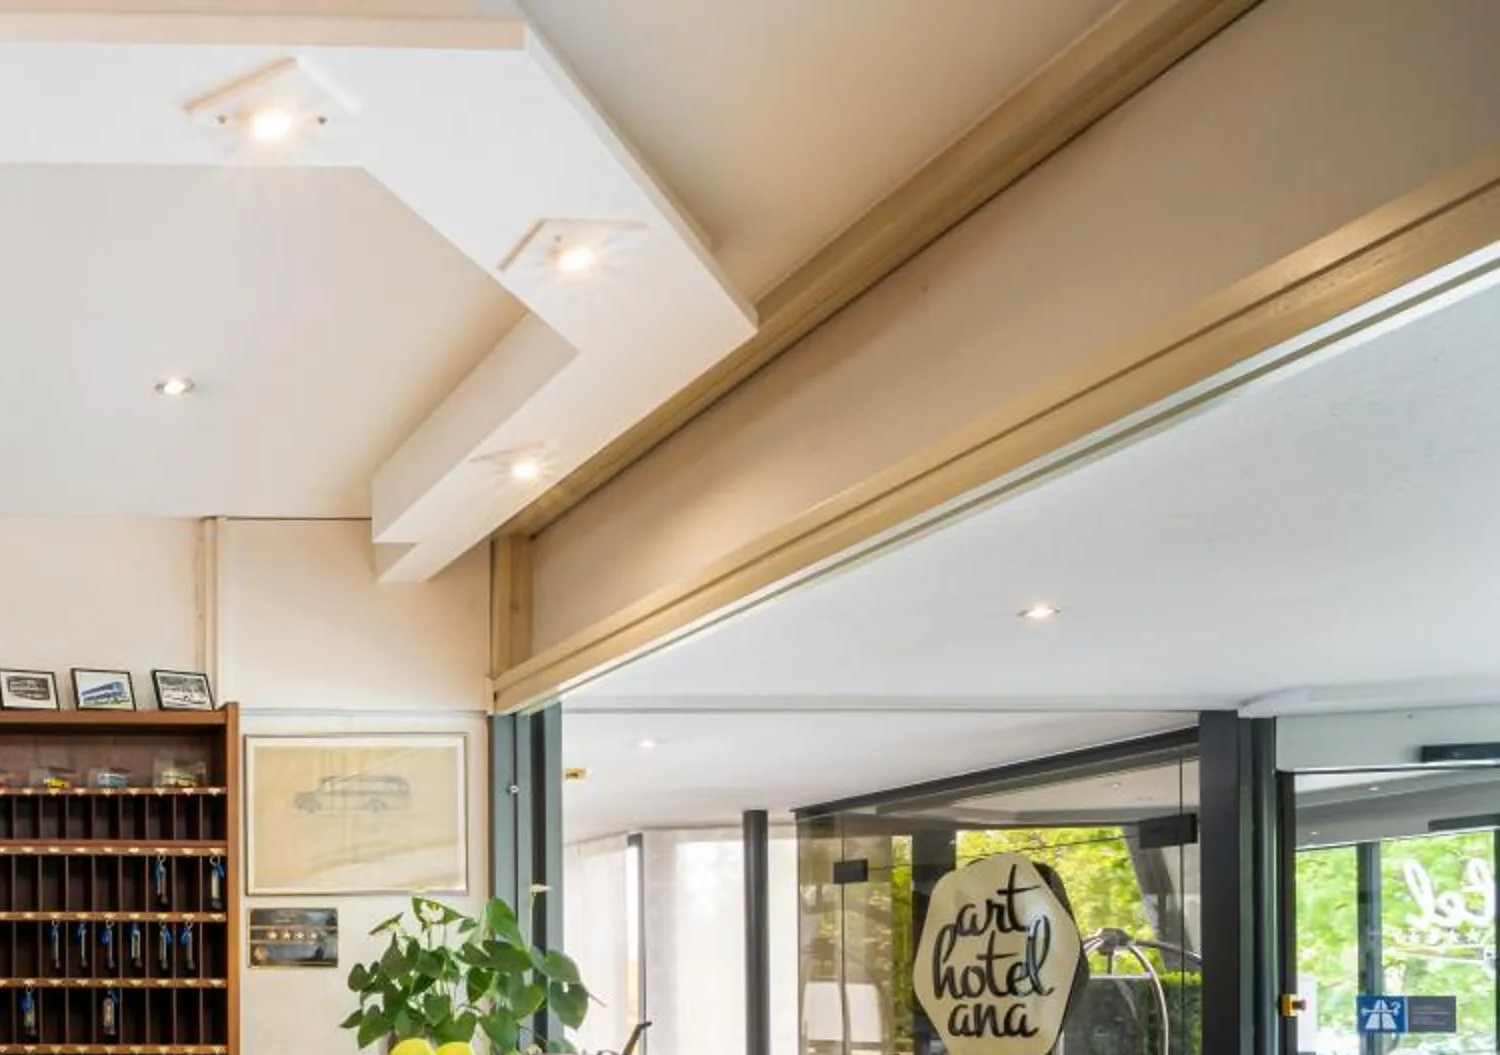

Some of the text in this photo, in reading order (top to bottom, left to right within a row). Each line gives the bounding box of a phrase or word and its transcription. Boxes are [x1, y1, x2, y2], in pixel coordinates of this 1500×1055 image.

[955, 864, 1040, 937] art
[932, 914, 1055, 1000] hotel
[947, 1003, 1040, 1038] ana
